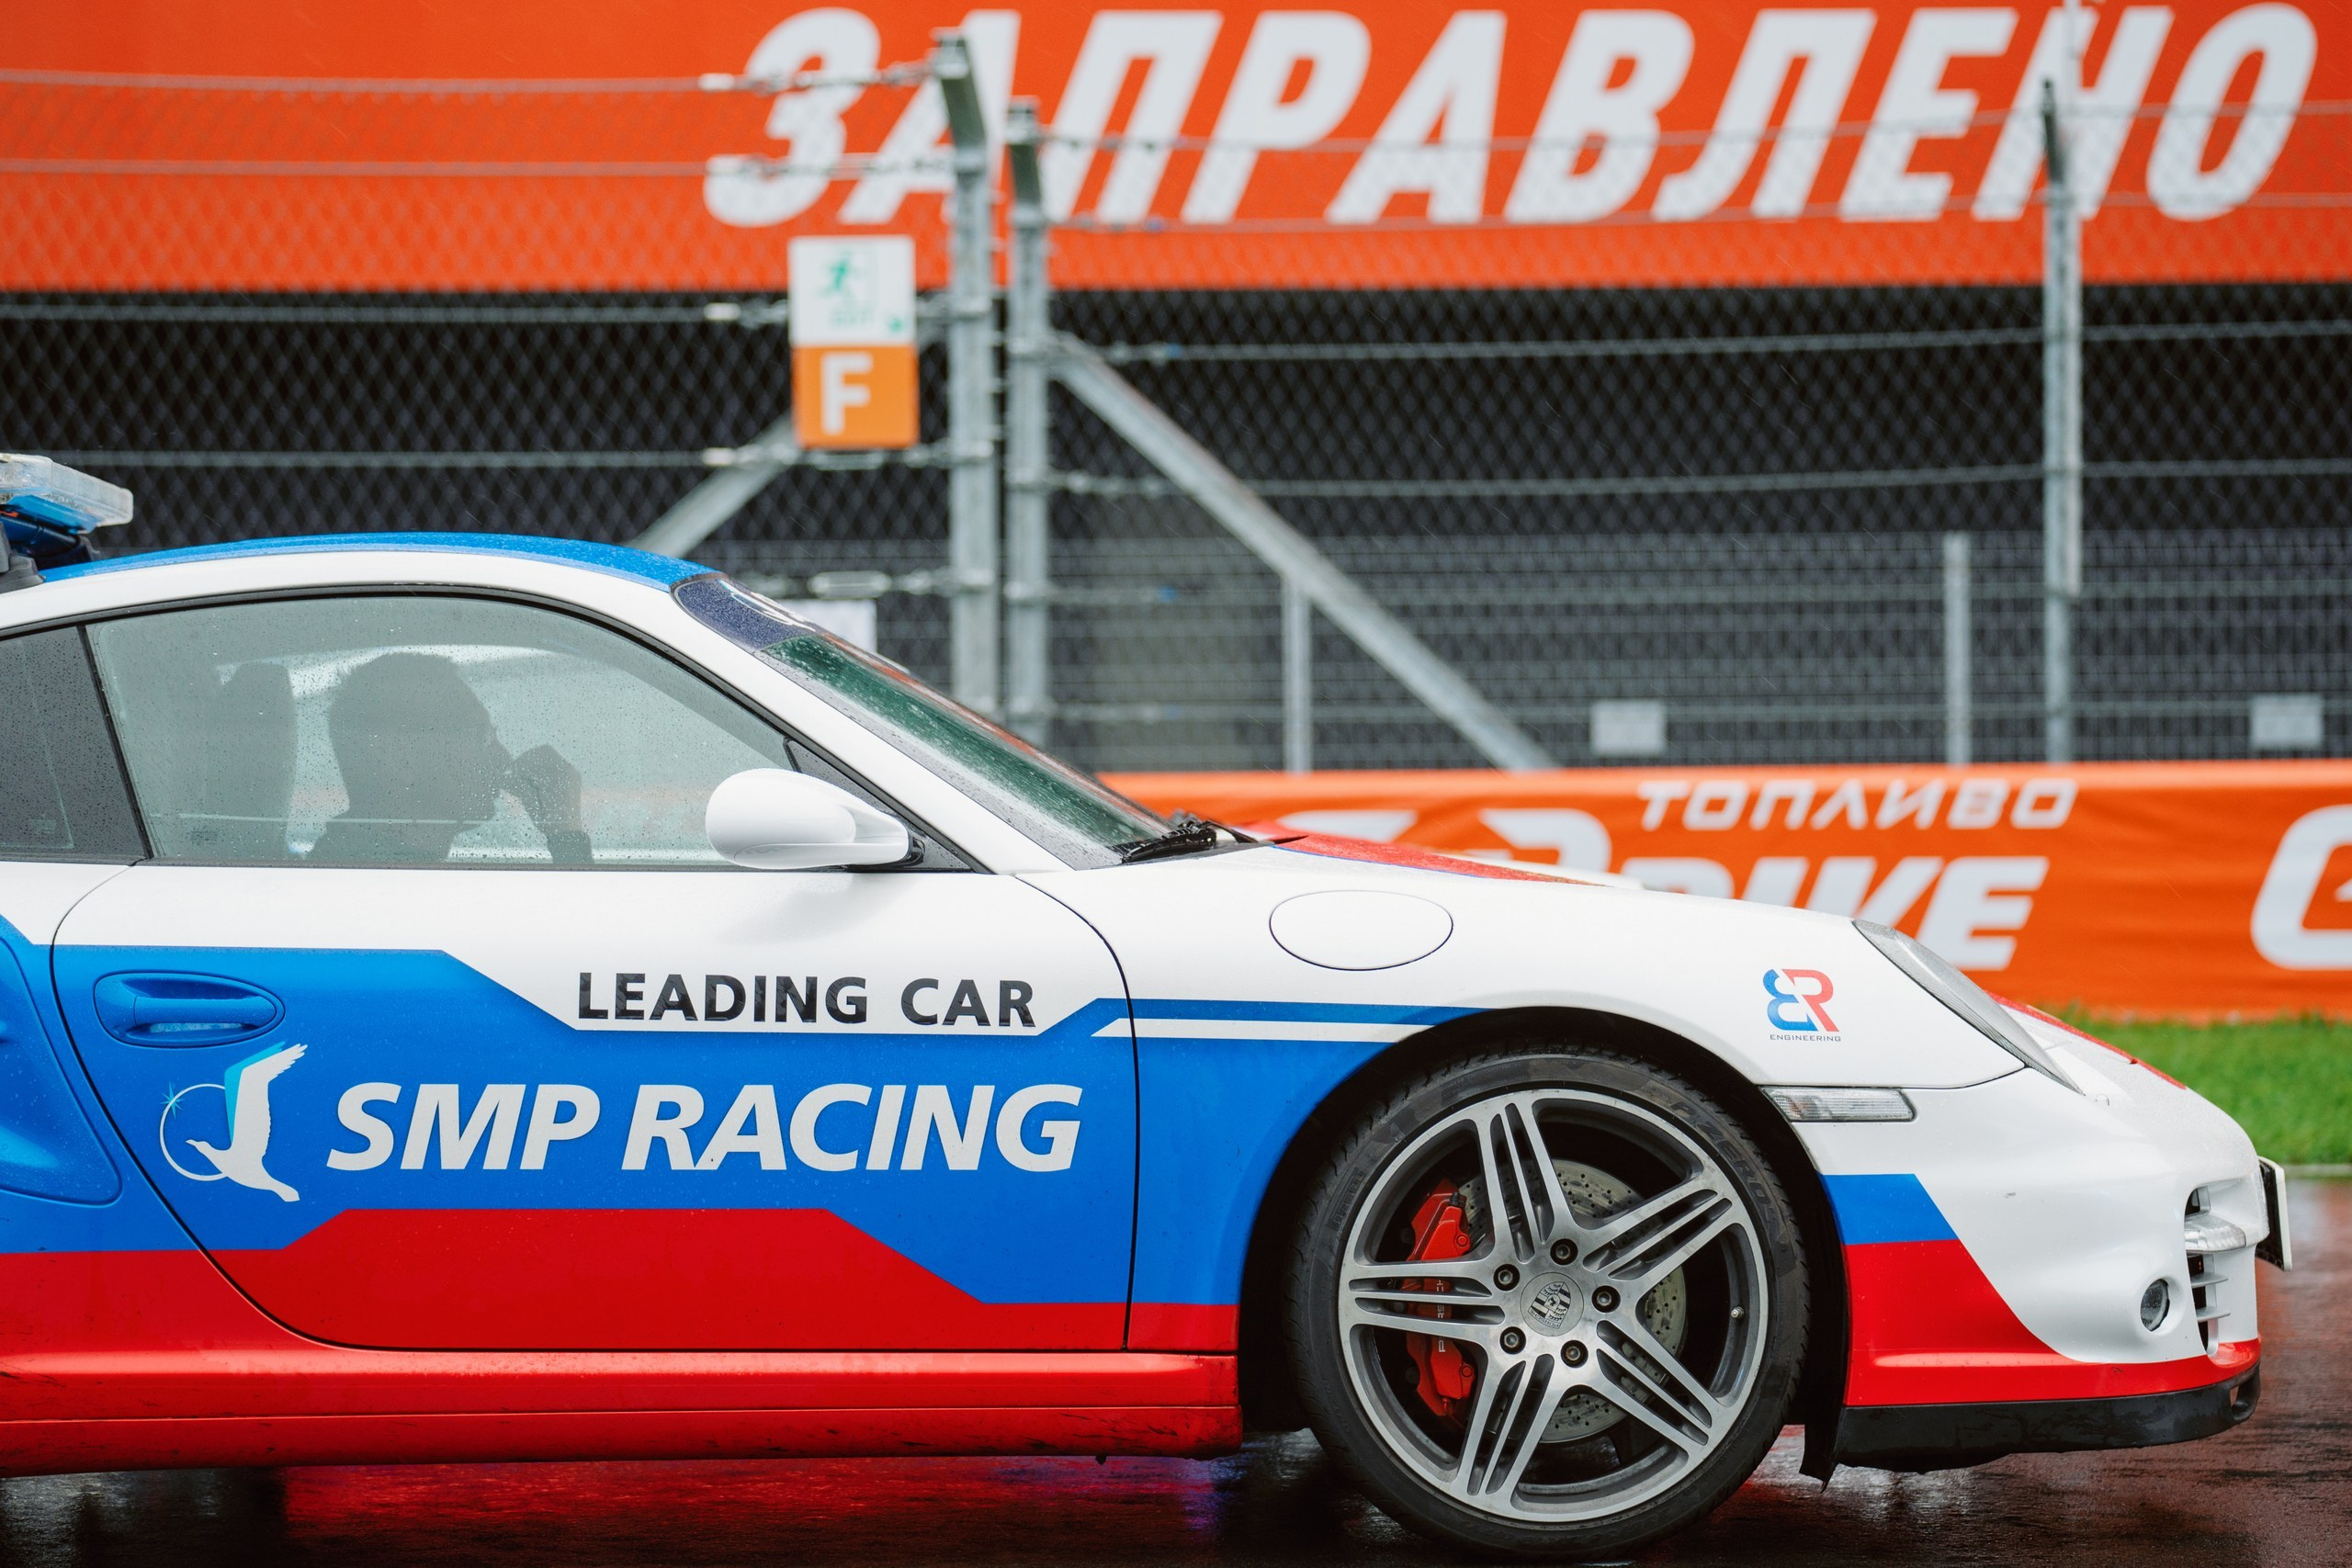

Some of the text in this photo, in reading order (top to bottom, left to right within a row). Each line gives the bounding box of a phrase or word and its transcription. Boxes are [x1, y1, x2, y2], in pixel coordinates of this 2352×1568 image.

[703, 3, 2318, 227] ЗАПРАВЛЕНО
[820, 352, 873, 435] F
[1637, 778, 2078, 830] ТОПЛИВО
[578, 973, 1035, 1027] LEADING CAR
[327, 1082, 1083, 1172] SMP RACING
